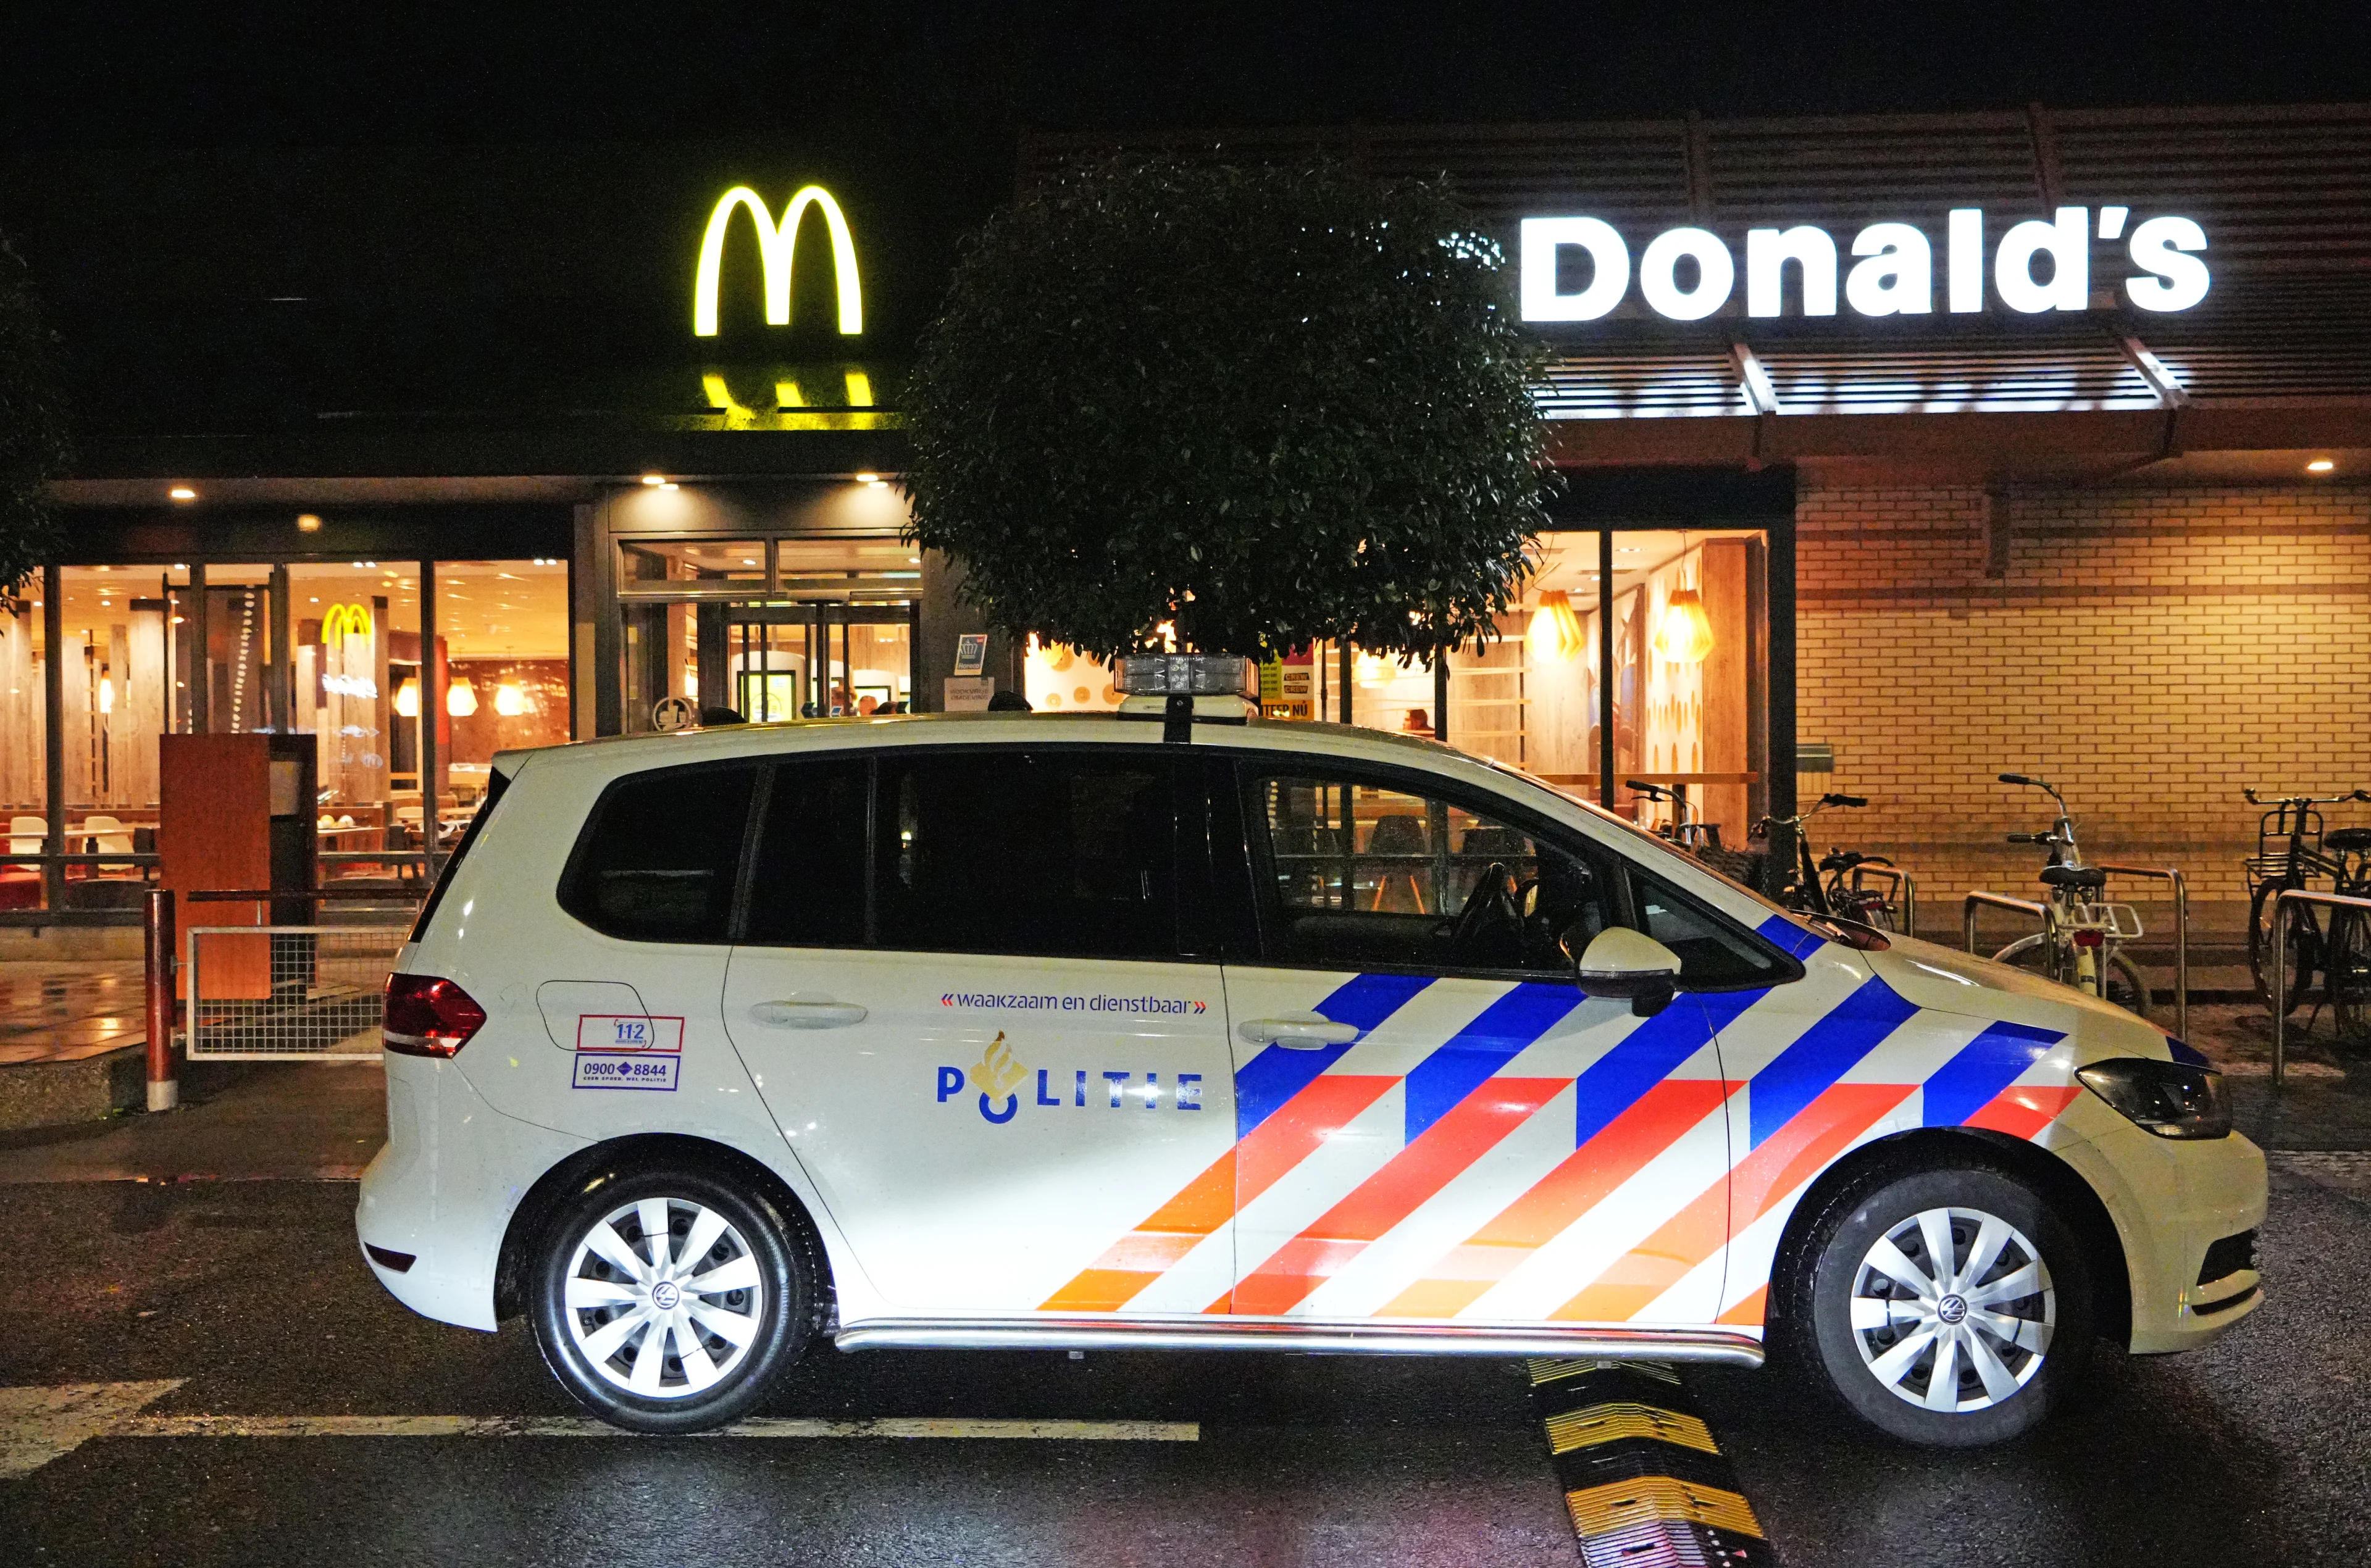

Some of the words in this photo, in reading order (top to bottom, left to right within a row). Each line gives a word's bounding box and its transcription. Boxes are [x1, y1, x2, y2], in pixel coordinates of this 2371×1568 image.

[1437, 206, 2212, 322] Donald's
[1062, 996, 1085, 1011] en
[584, 1063, 615, 1075] 0900
[634, 1064, 666, 1076] 8844
[937, 1065, 1202, 1124] POLITIE
